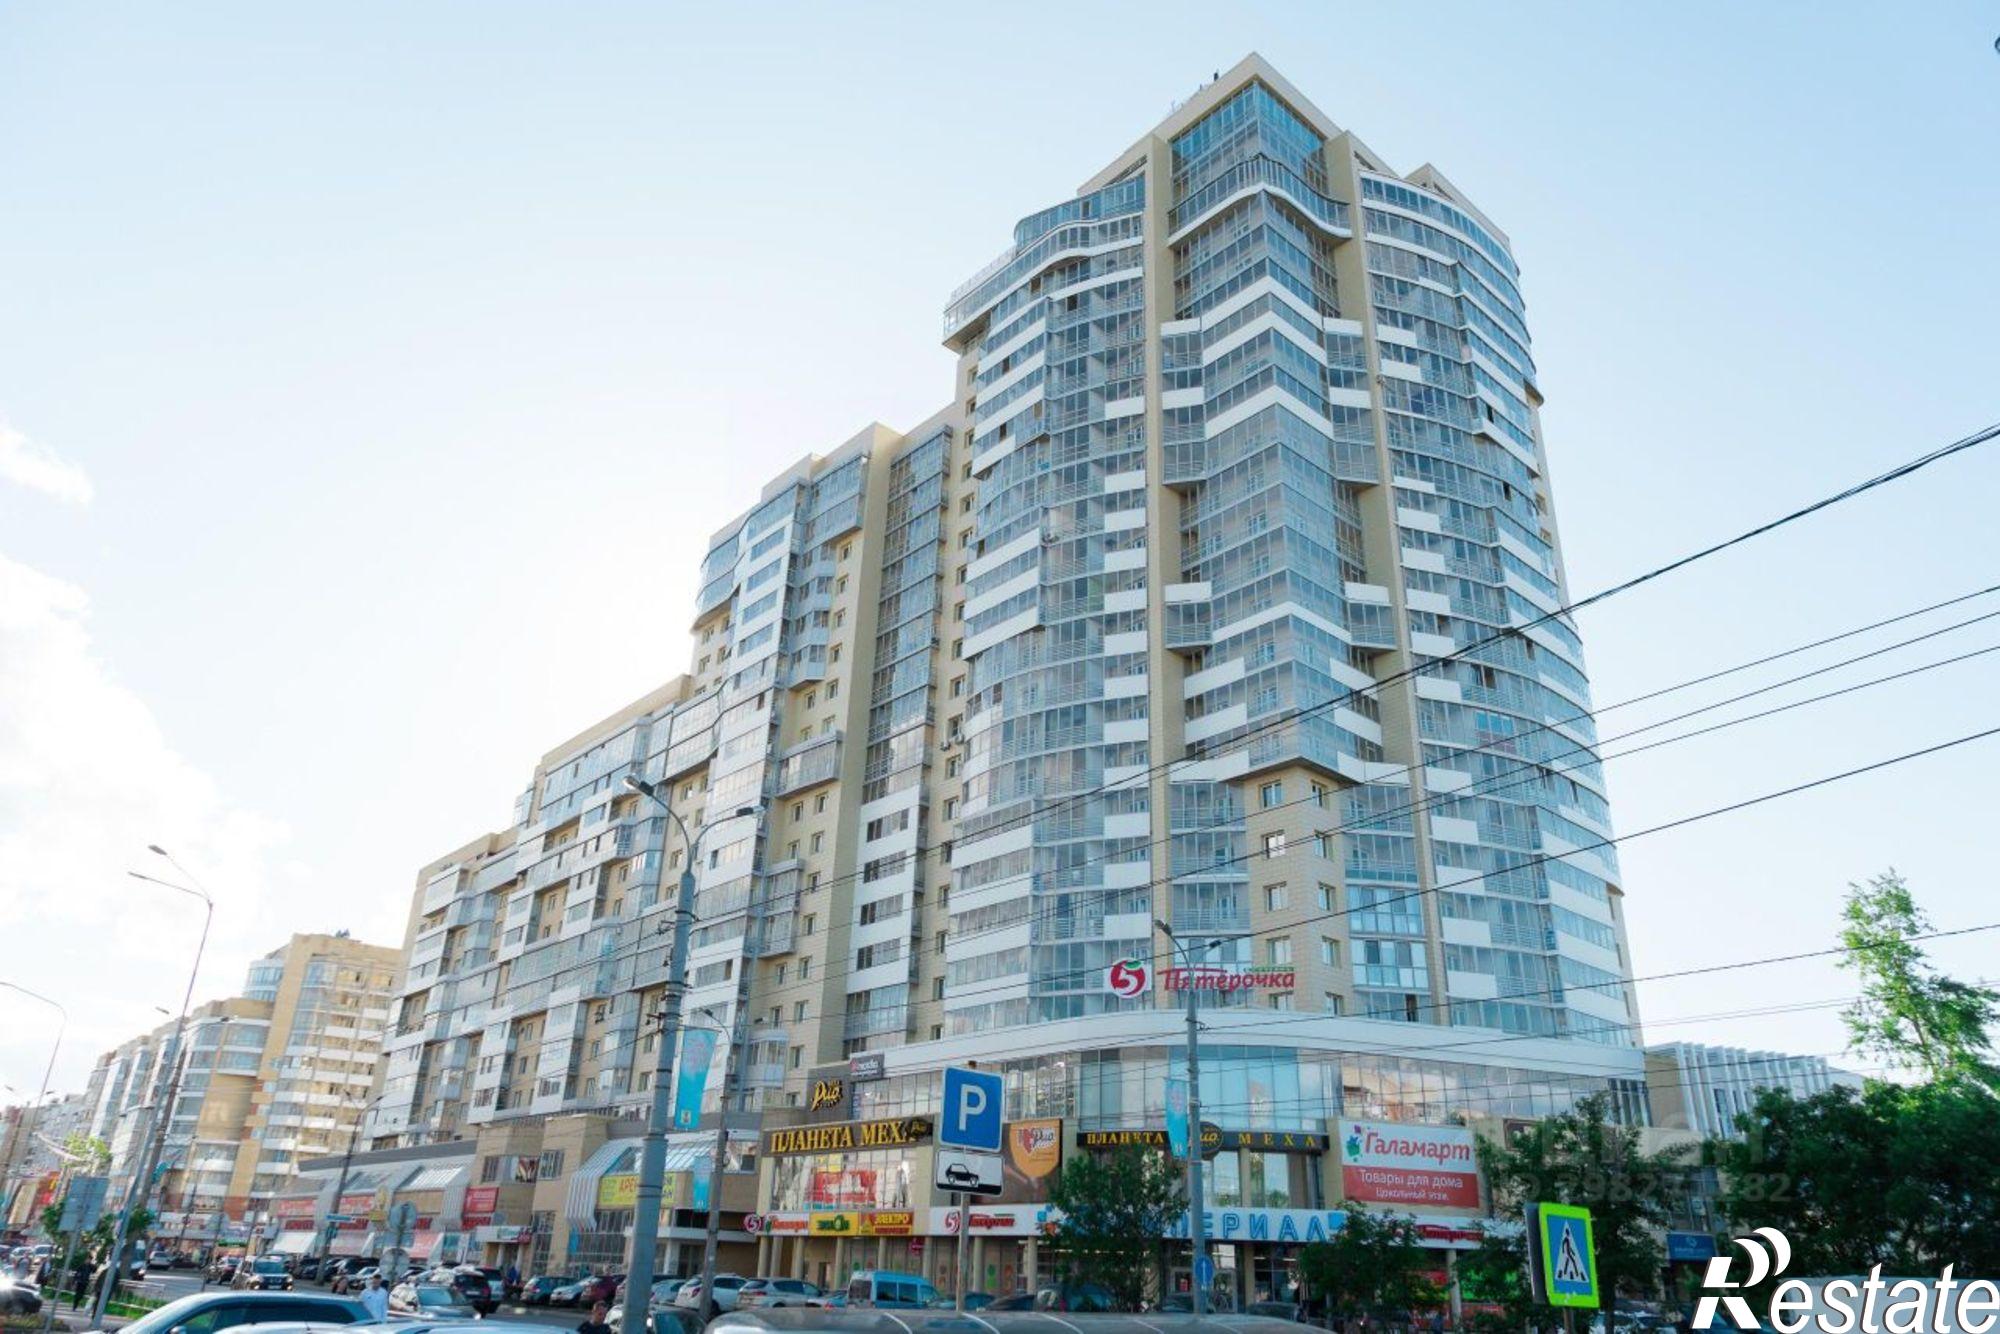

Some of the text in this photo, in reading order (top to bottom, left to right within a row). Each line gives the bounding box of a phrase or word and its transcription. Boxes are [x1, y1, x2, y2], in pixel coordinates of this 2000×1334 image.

[771, 1126, 854, 1154] ПЛАНЕТА
[1238, 1131, 1317, 1147] МЕХА
[1364, 1132, 1470, 1165] Галамарт
[1359, 1168, 1464, 1189] Товары для дома
